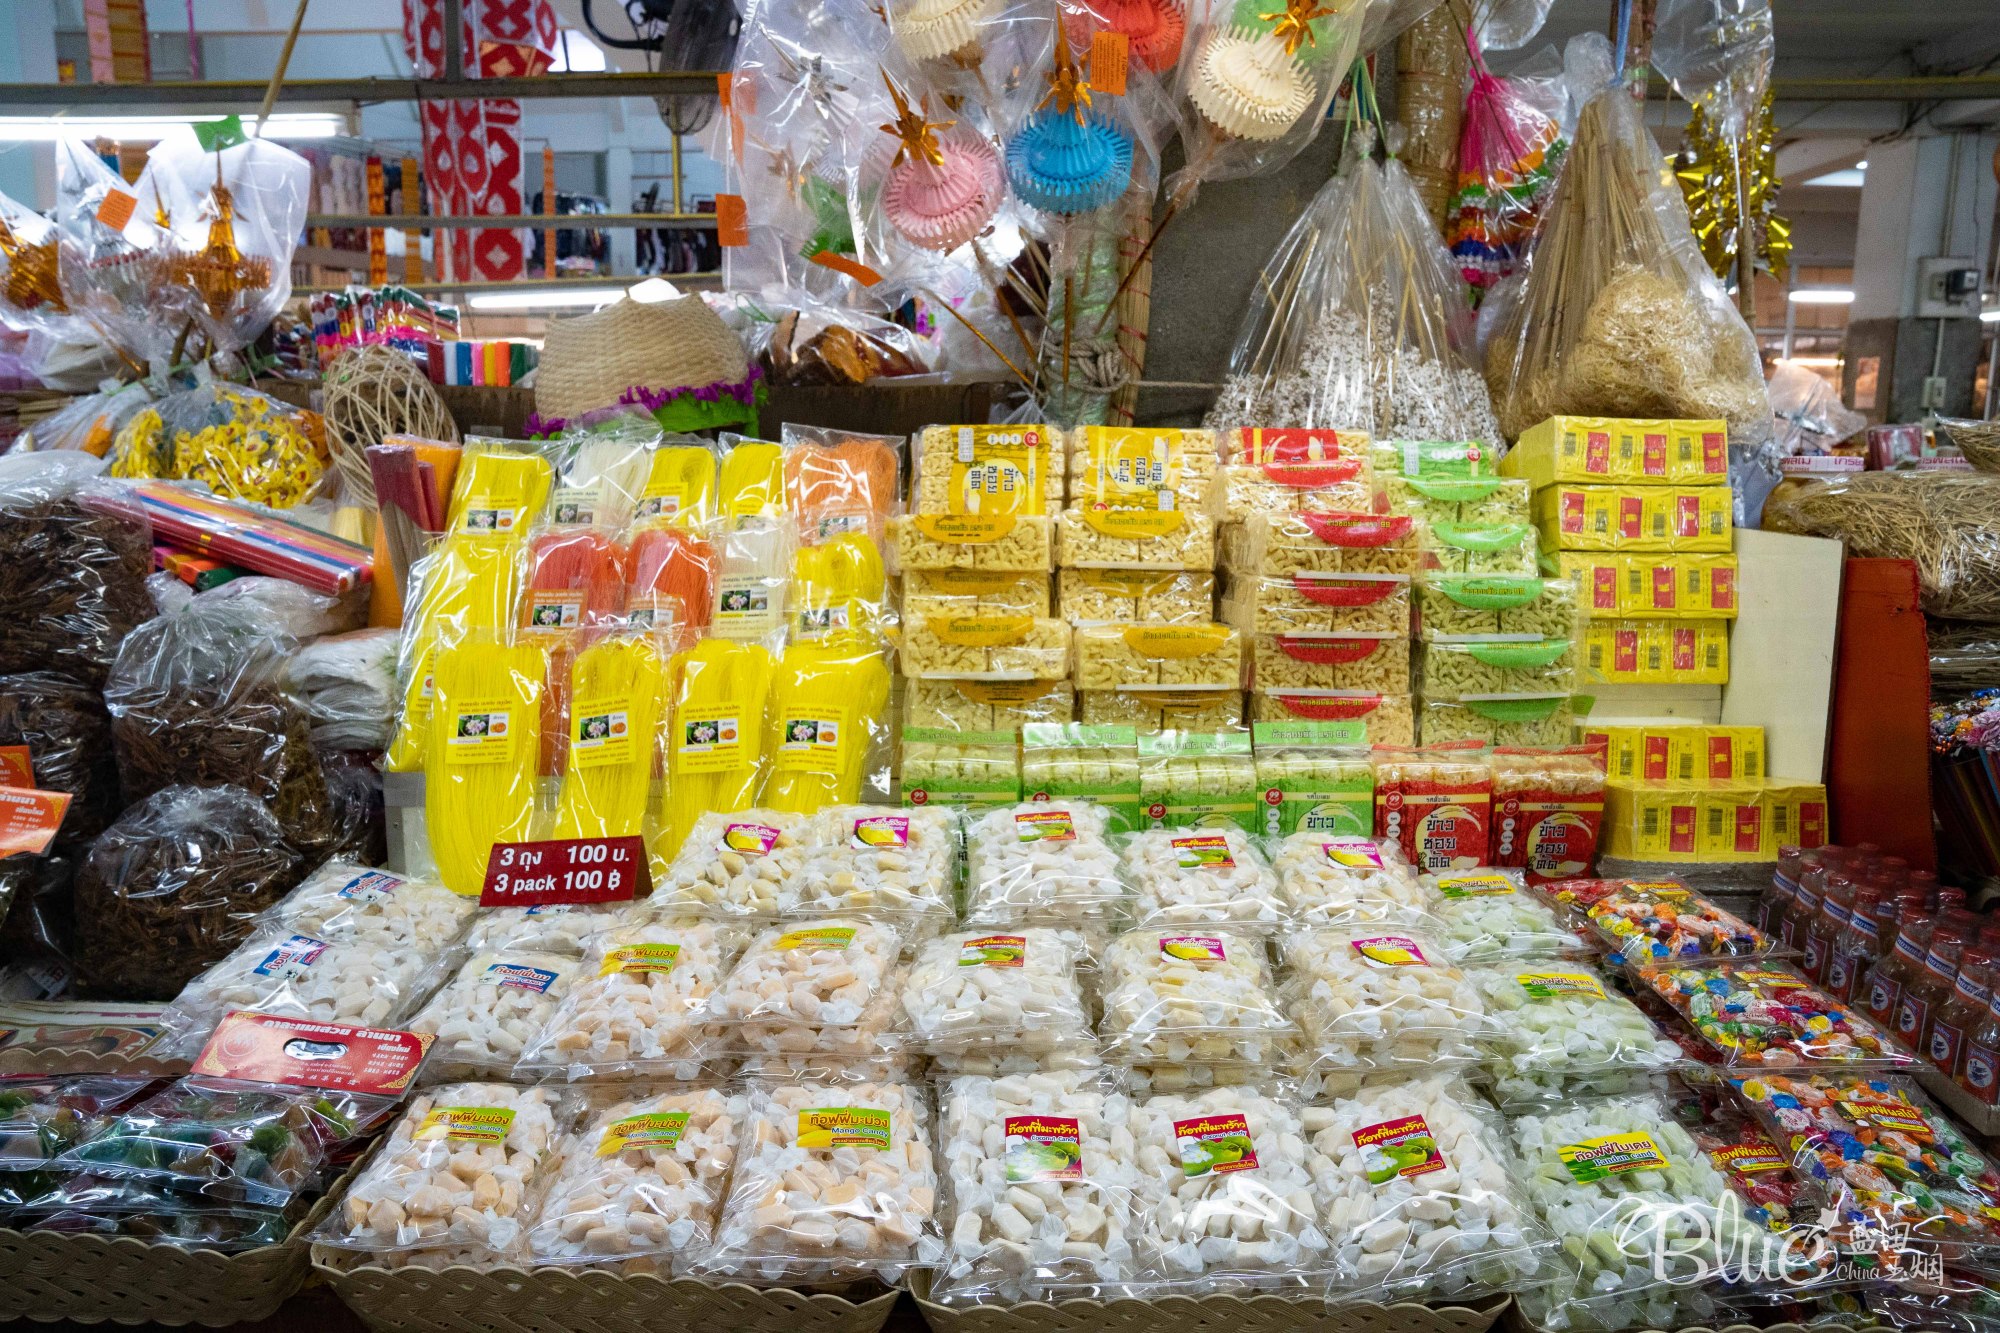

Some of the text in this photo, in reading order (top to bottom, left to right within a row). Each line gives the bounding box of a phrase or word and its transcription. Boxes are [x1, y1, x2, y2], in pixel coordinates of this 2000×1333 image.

[1307, 811, 1334, 828] ข้าว
[1427, 814, 1454, 831] ข้าว
[1539, 820, 1565, 837] ข้าว
[1424, 838, 1455, 849] ซอย
[1535, 843, 1567, 854] ซอย
[500, 845, 630, 871] 3 ถุง 100 บ.
[1429, 851, 1451, 868] ตัด
[1536, 855, 1558, 869] ตัด
[494, 869, 621, 895] 3 pack 100 ฿
[862, 1127, 889, 1138] Candy
[1031, 1134, 1056, 1142] Coconut
[1382, 1131, 1428, 1145] Coconut Candy
[1594, 1150, 1657, 1167] Pandan candy
